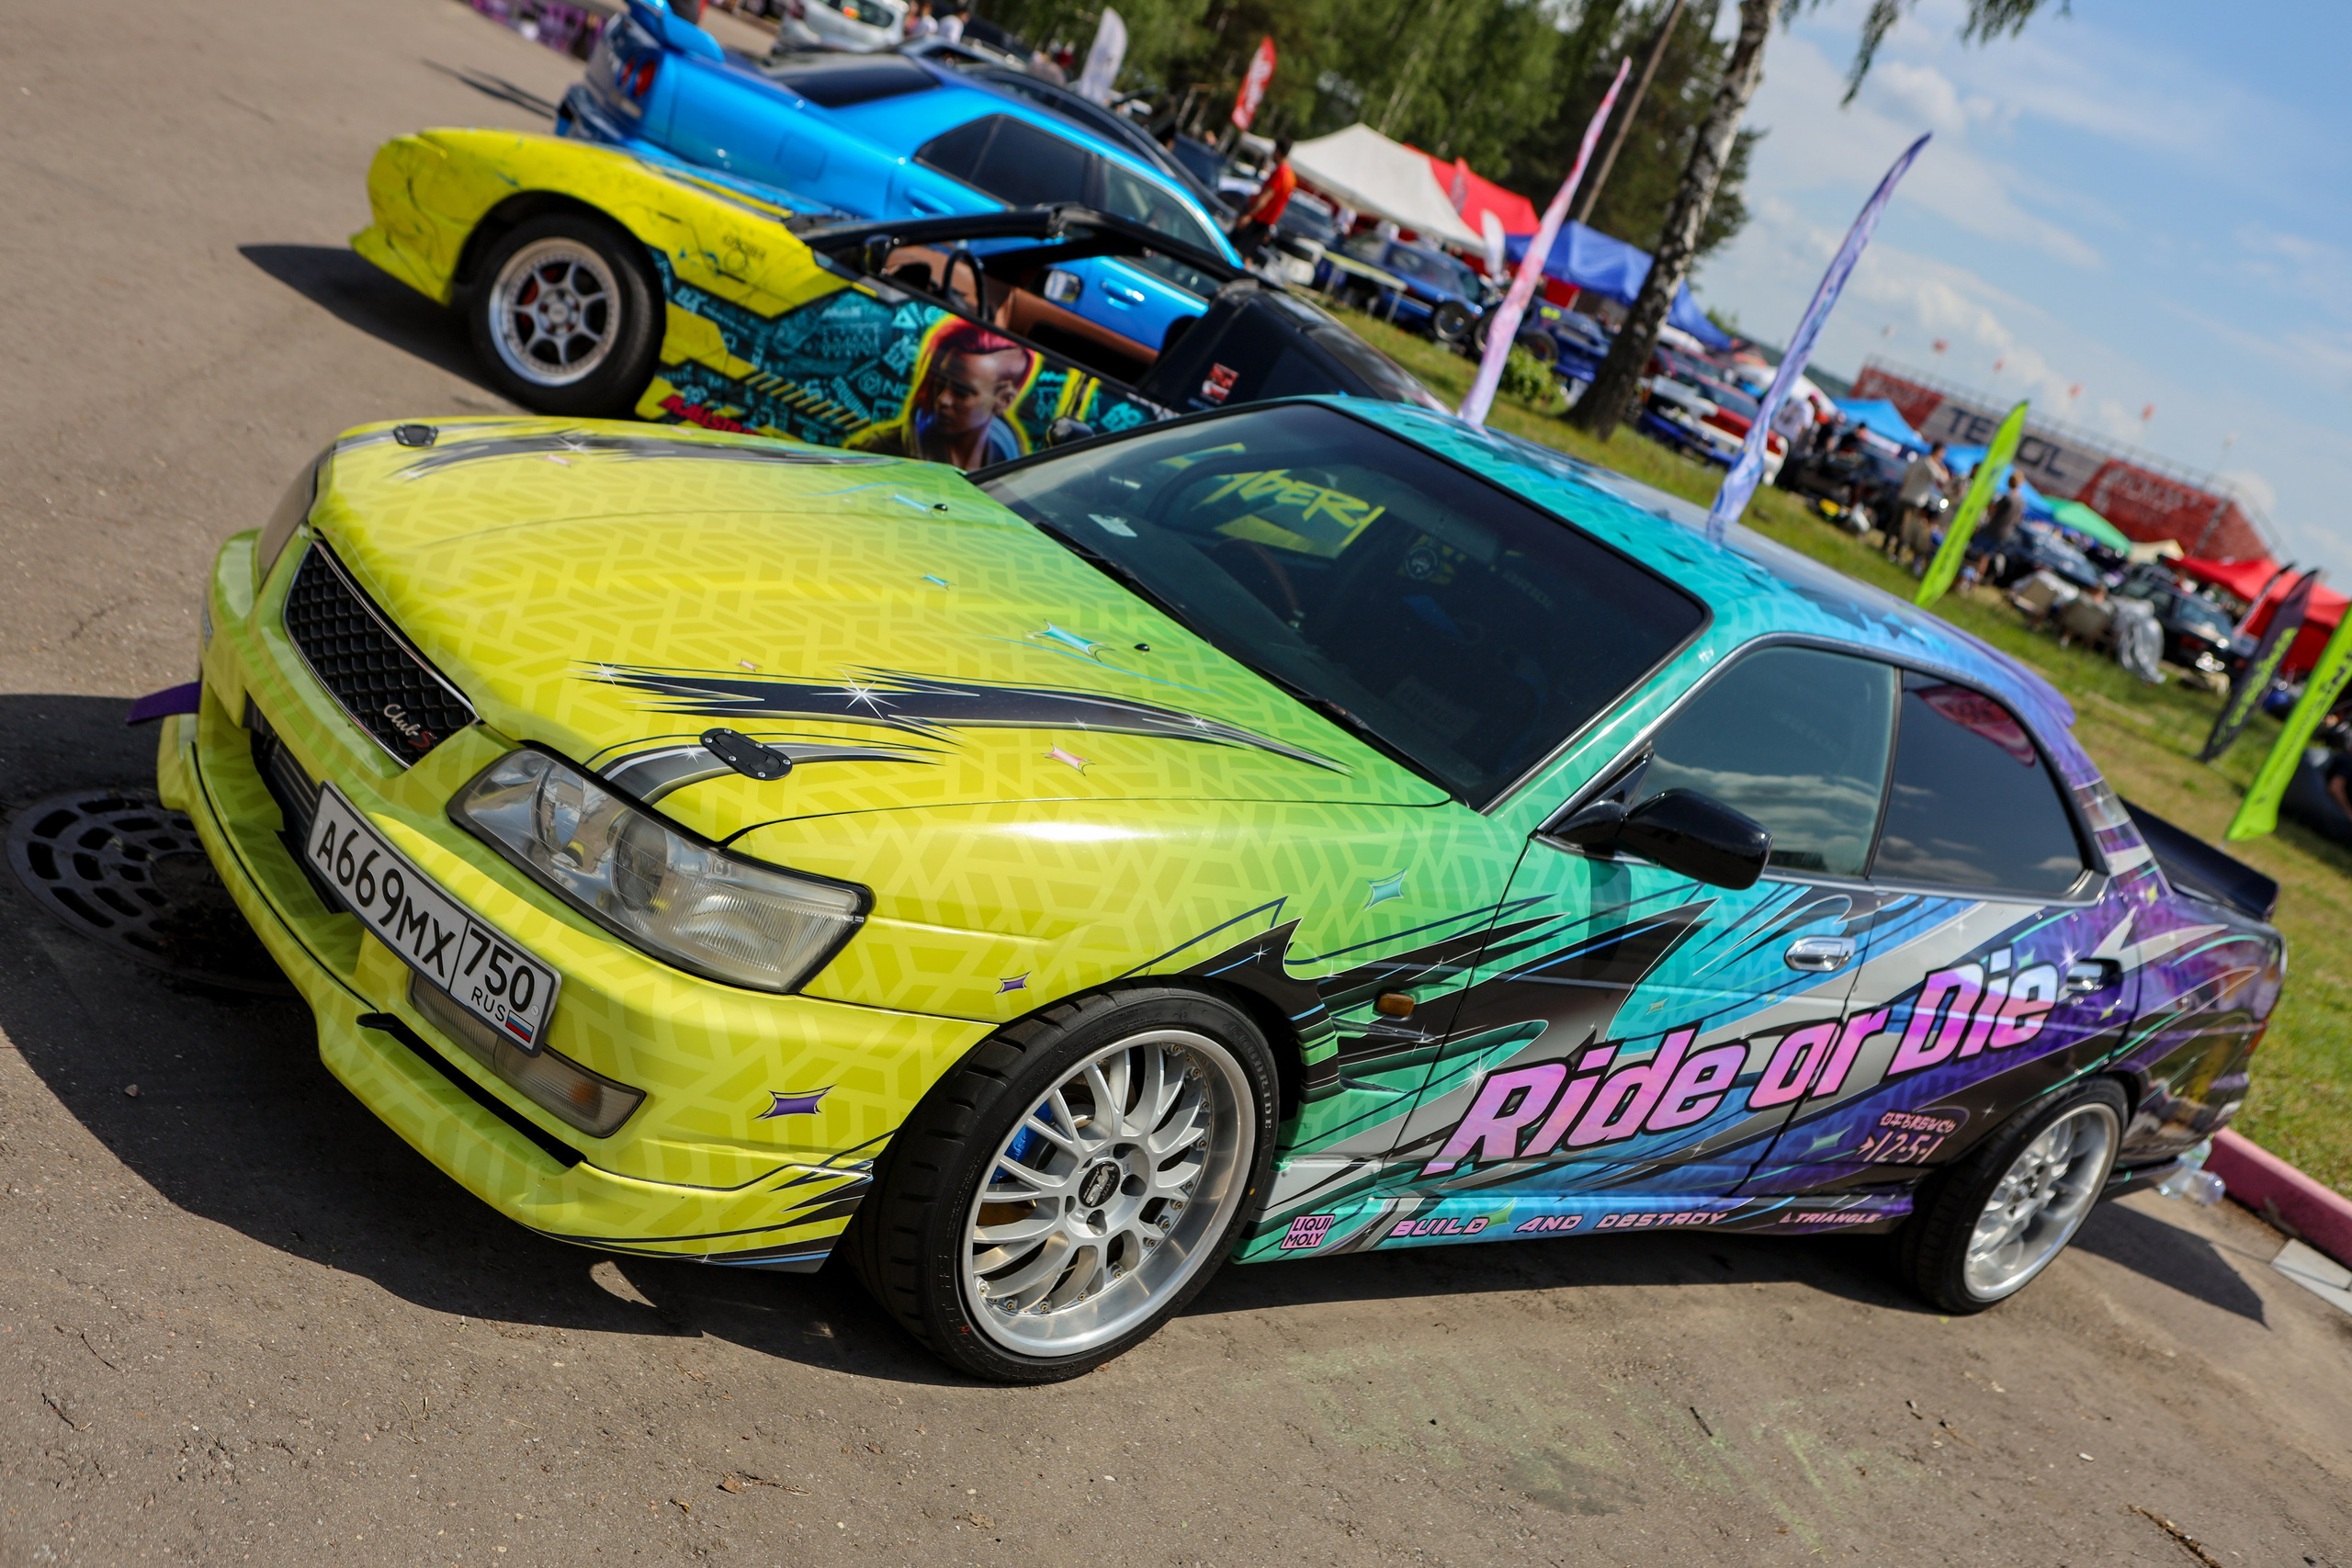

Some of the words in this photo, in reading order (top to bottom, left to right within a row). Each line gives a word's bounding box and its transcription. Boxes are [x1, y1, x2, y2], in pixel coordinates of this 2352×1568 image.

[1950, 408, 2065, 477] TEOL
[384, 704, 421, 736] Club
[407, 730, 437, 749] S
[317, 820, 456, 978] A669MX
[462, 928, 536, 1011] 750
[471, 986, 505, 1021] RUS
[1420, 1025, 1748, 1179] Ride
[1748, 1008, 1890, 1112] or
[1887, 947, 2058, 1076] Die
[1293, 1217, 1330, 1231] LIQUI
[1389, 1217, 1490, 1237] BUILD
[1514, 1214, 1584, 1234] AND
[1794, 1213, 1883, 1224] TRIANGLE
[1286, 1233, 1323, 1247] MOLY
